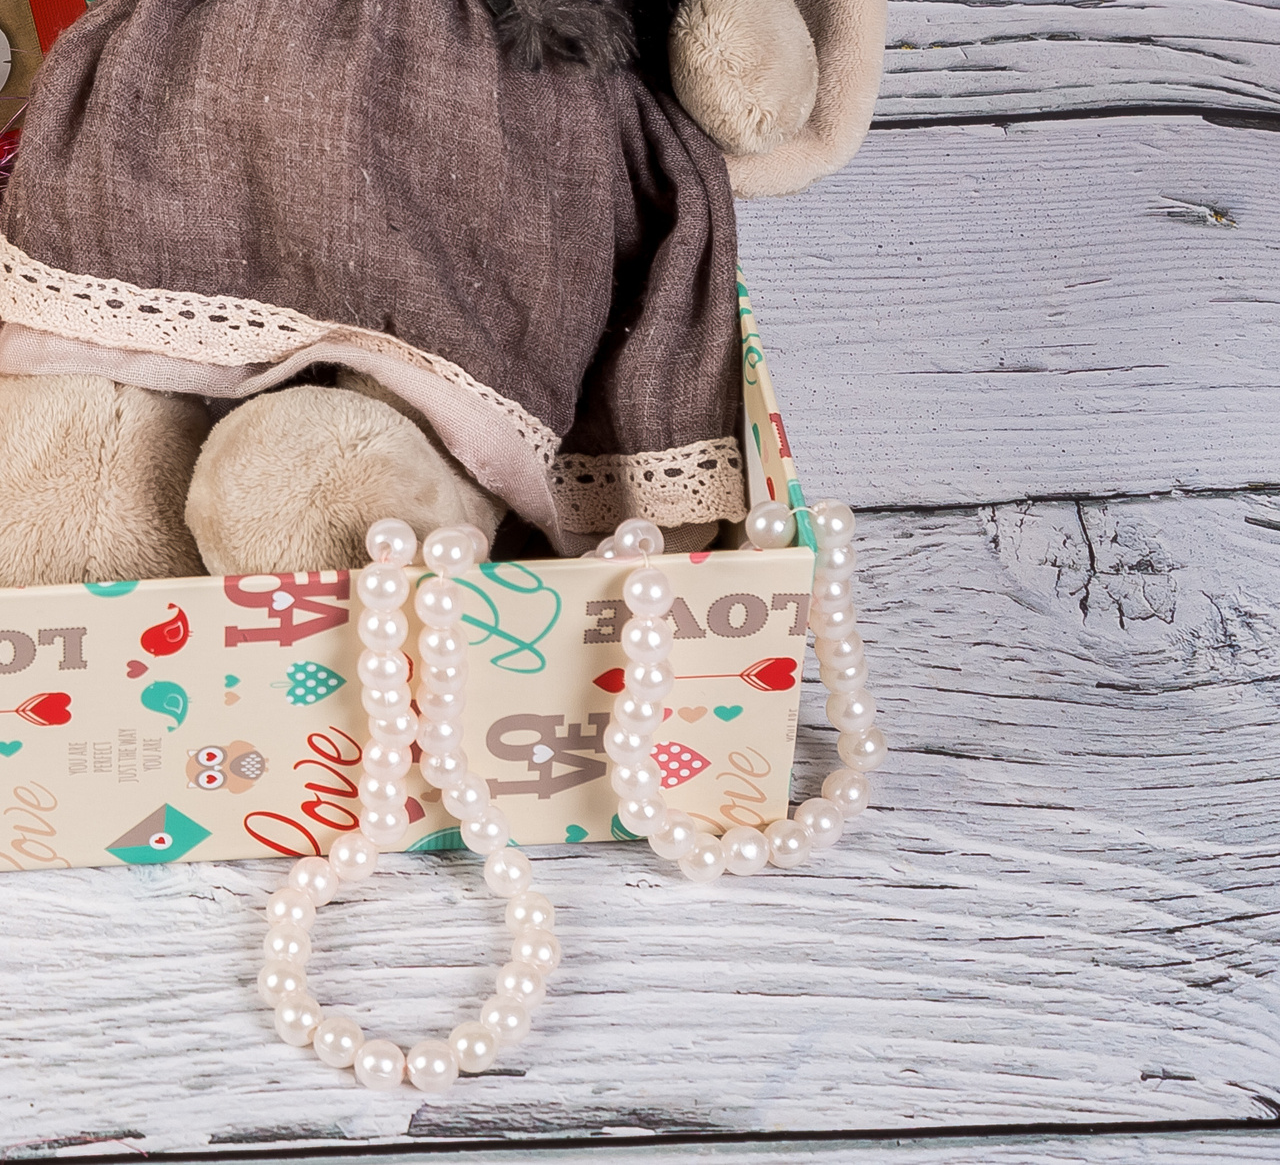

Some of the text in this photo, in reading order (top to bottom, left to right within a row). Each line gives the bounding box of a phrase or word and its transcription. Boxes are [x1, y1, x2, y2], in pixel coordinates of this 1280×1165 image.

[68, 741, 88, 776] YOU ARE
[93, 741, 112, 773] PERFECT
[118, 728, 139, 784] JUST THE WAY
[142, 737, 162, 772] YOU ARE
